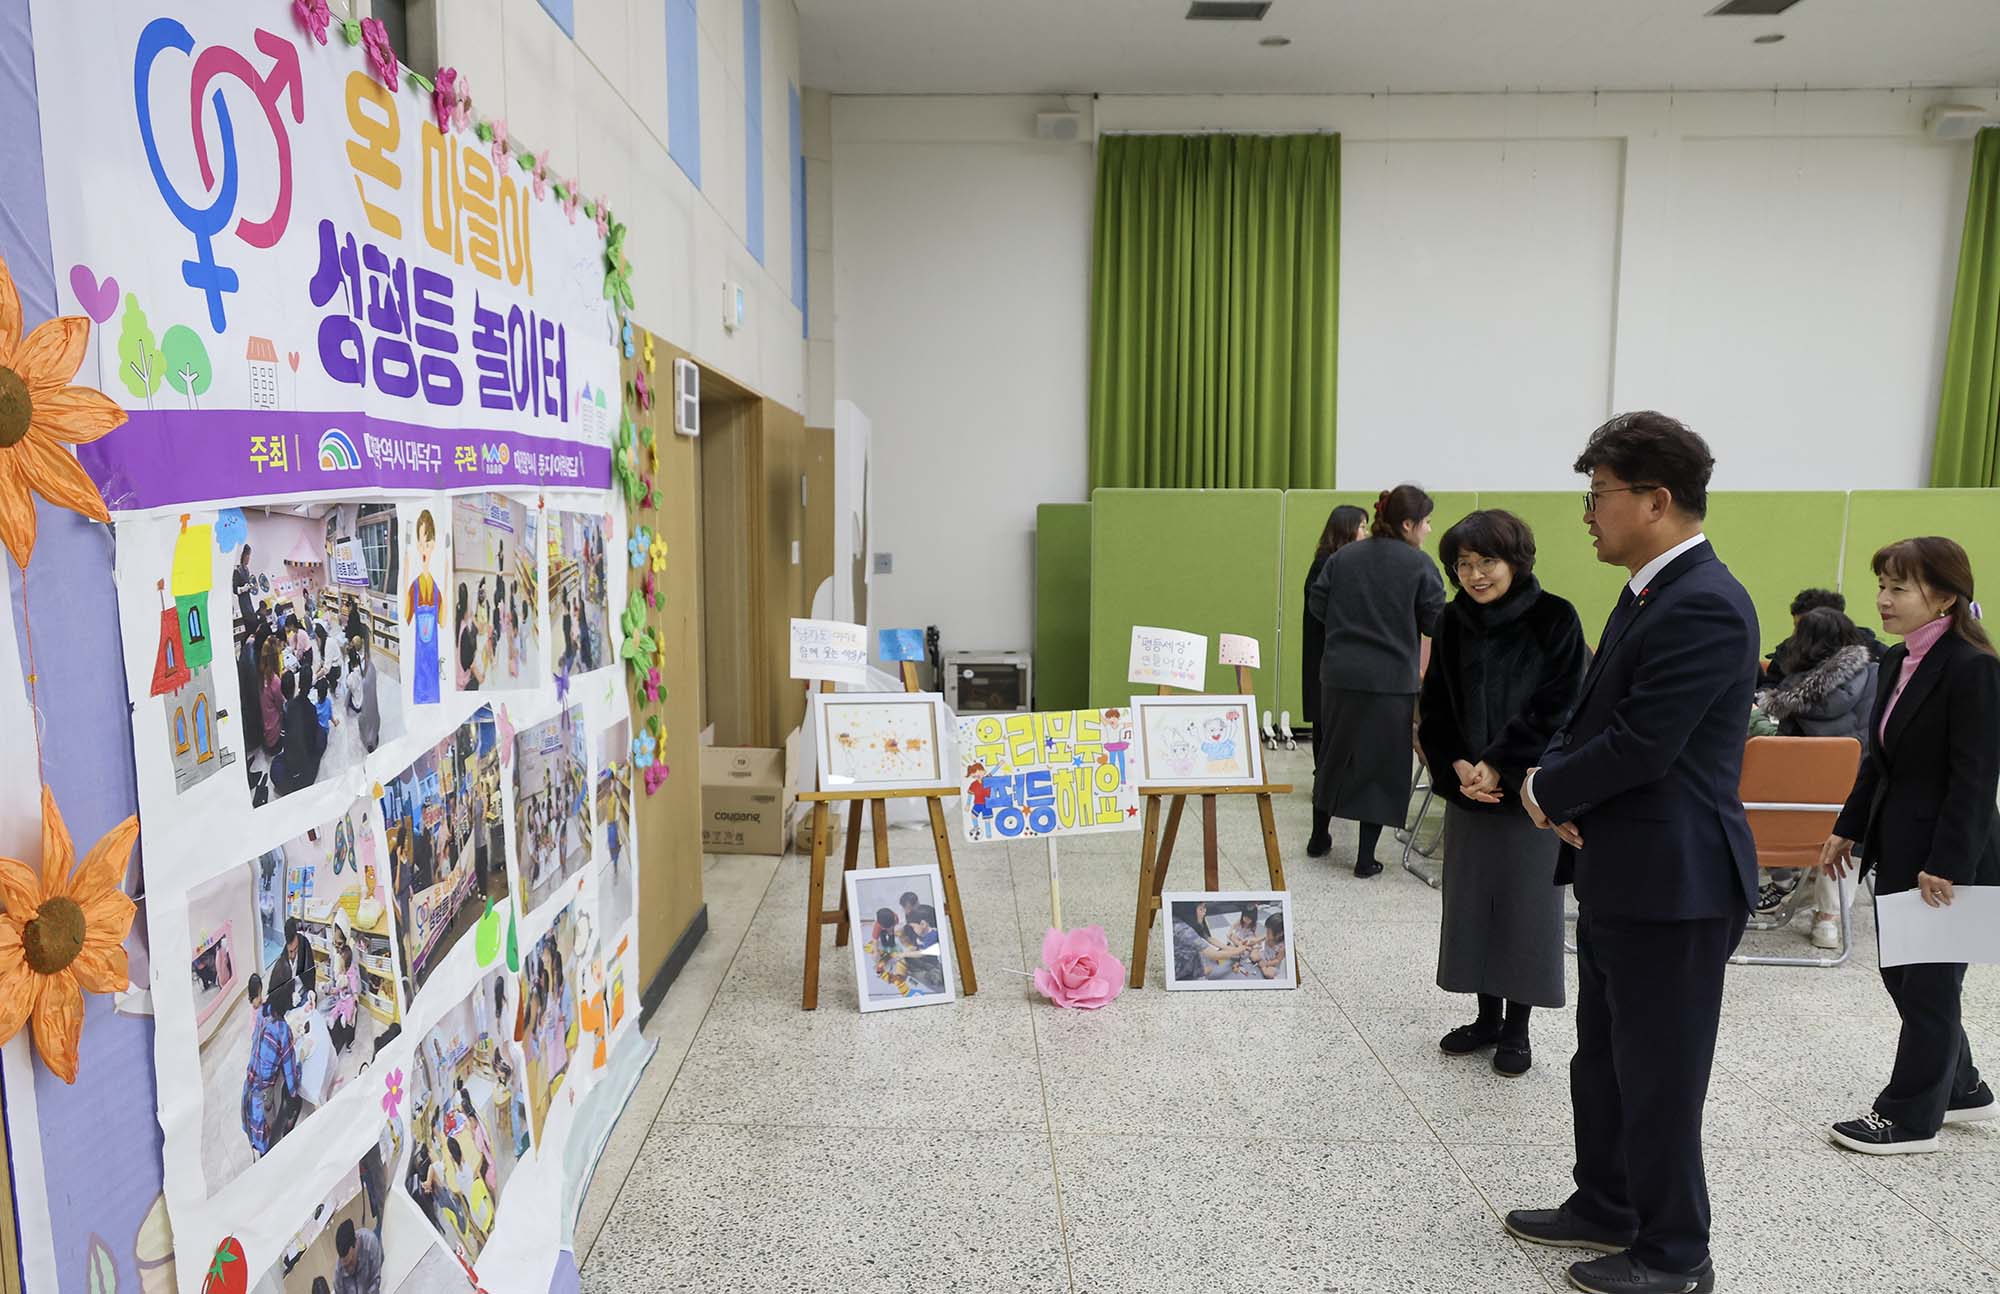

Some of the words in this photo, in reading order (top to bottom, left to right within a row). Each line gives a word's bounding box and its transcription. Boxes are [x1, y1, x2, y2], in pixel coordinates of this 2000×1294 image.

[345, 70, 402, 240] 온
[421, 120, 534, 296] 마을이
[309, 218, 464, 407] 성평등
[472, 288, 568, 422] 놀이터
[249, 434, 288, 473] 주최
[454, 445, 478, 473] 주관
[714, 811, 761, 824] coupang
[983, 763, 1124, 837] 평등해요
